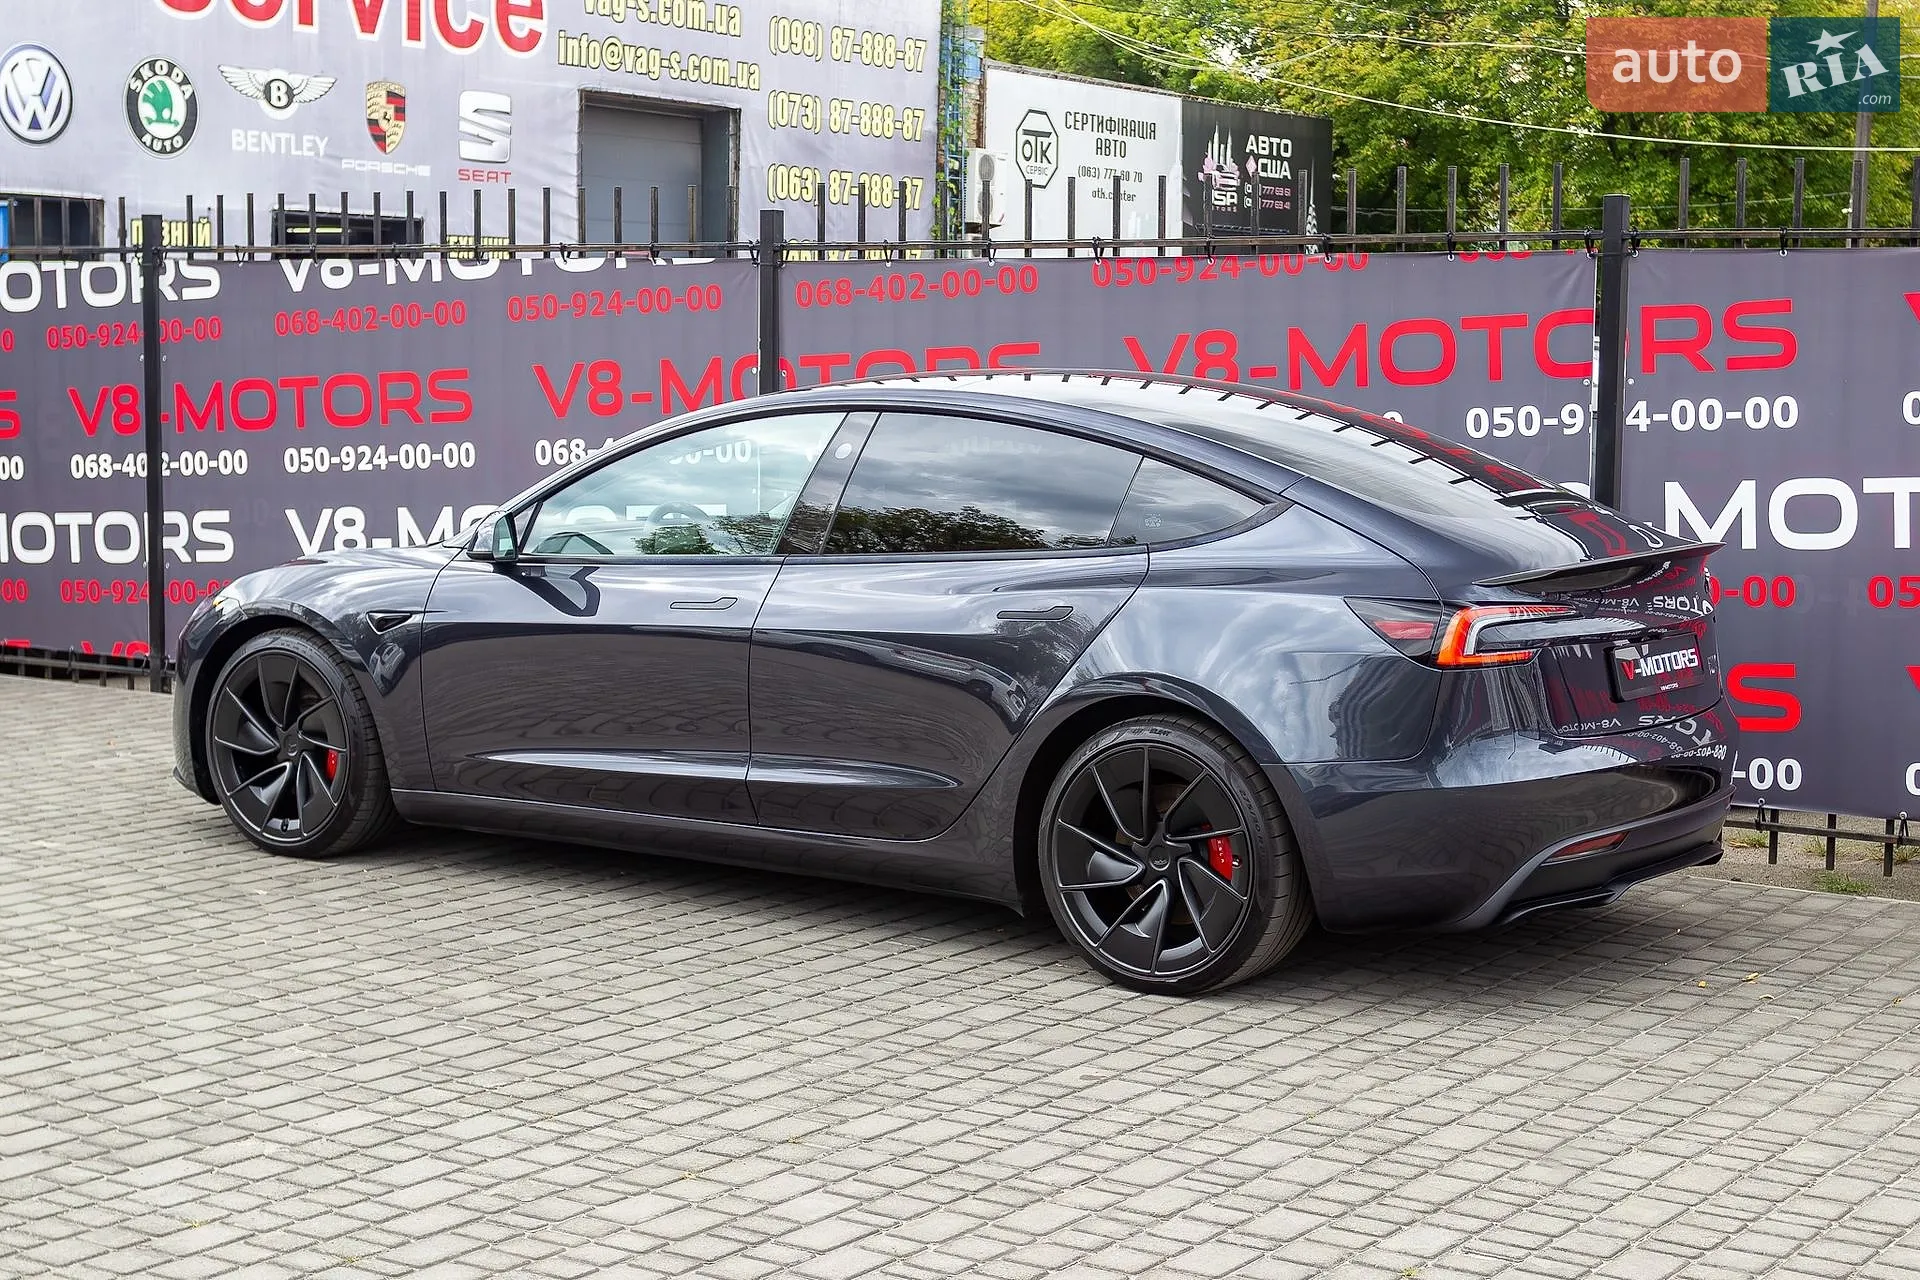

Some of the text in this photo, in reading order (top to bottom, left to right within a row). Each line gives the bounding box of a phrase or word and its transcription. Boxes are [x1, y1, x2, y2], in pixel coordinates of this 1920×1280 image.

[558, 30, 760, 91] info@vag-s.com.ua
[769, 16, 927, 72] (098) 87-888-87
[768, 90, 925, 142] (073) 87-888-87
[1065, 111, 1157, 140] СЕРТИФІКАЦІЯ
[141, 133, 184, 152] AUTO
[231, 128, 328, 157] BENTLEY
[1095, 137, 1127, 158] АВТО
[1245, 134, 1293, 158] АВТО
[341, 158, 431, 176] PORSCHE
[457, 168, 512, 184] SEAT
[1257, 158, 1292, 180] США
[507, 283, 723, 323] 050-924-00-00
[795, 265, 1040, 309] 068-402-00-00
[274, 300, 467, 336] 068-402-00-00
[67, 369, 473, 438] V8-MOTORS
[1465, 396, 1799, 440] 050-94-00-00
[283, 441, 476, 474] 050-924-00-00
[0, 510, 235, 564] OTORS
[1621, 648, 1699, 681] V-MOTORS
